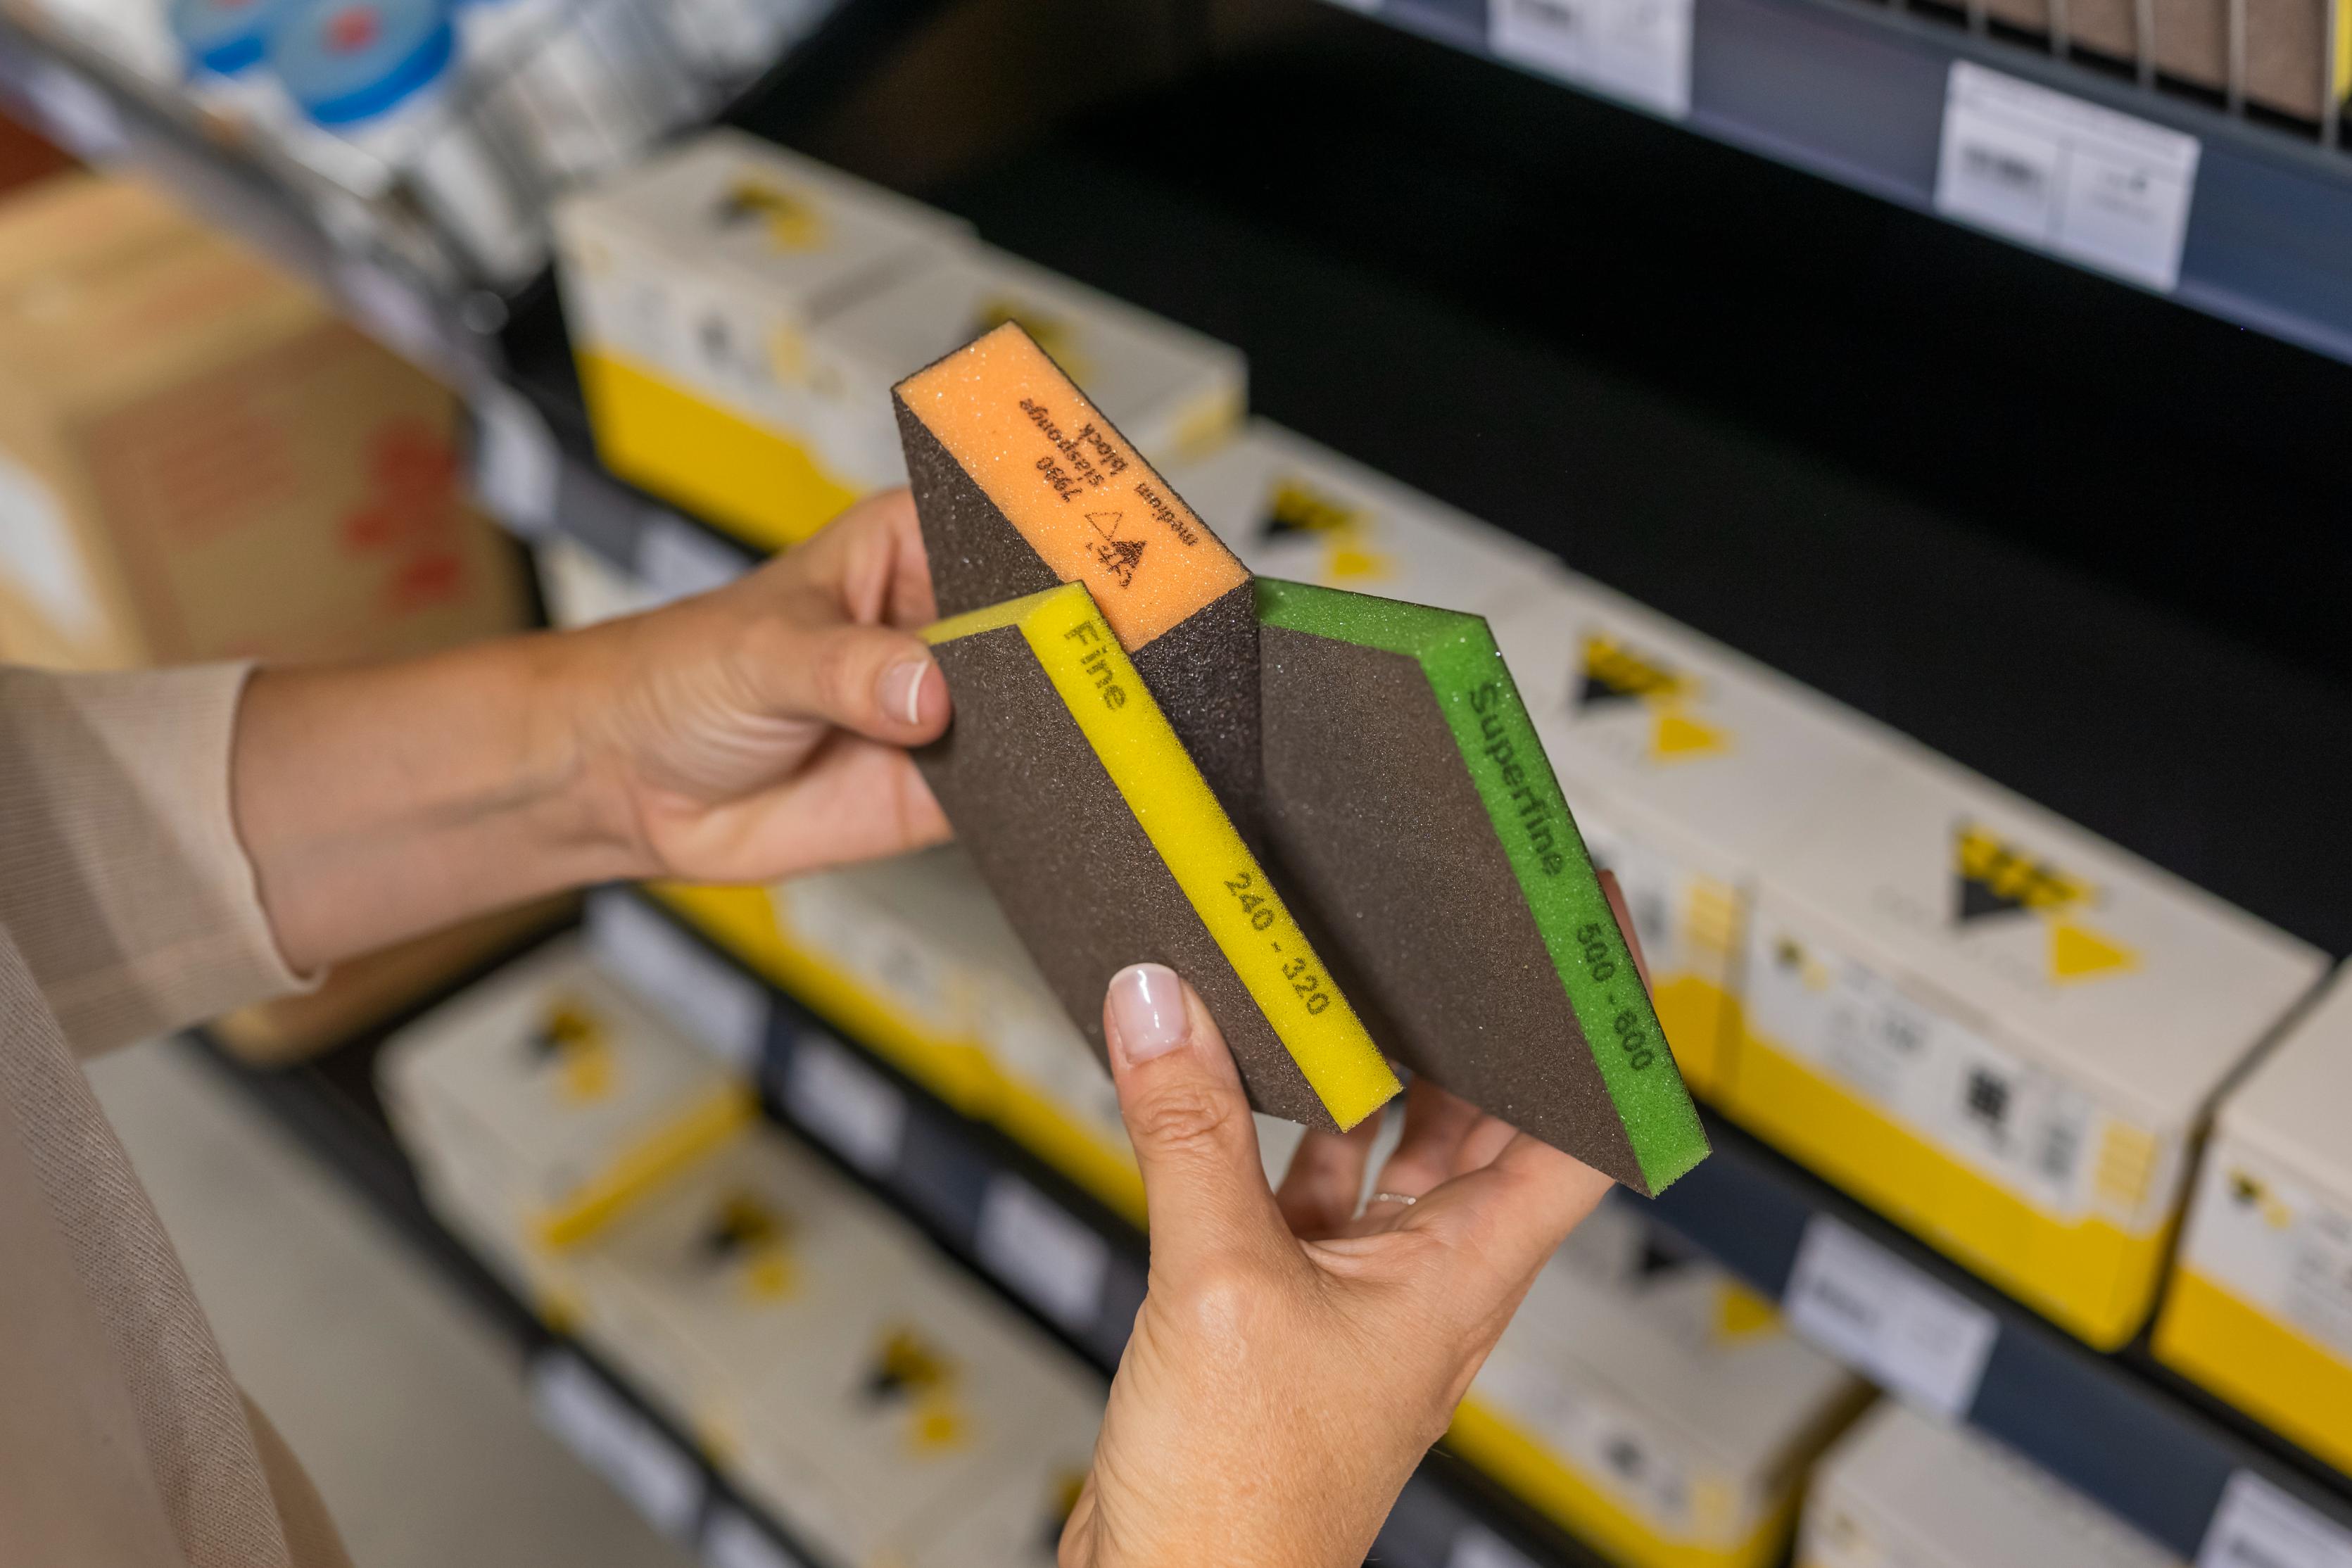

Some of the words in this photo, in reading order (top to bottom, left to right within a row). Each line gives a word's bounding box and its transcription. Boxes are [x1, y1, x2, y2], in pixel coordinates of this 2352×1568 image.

[1020, 398, 1104, 487] siasponge
[1079, 423, 1127, 476] block
[1134, 483, 1198, 547] medium
[1064, 619, 1126, 711] Fine
[1225, 871, 1275, 932] 240
[1282, 956, 1332, 1016] 320
[1469, 681, 1563, 878] Superfine
[1576, 922, 1614, 983] 500
